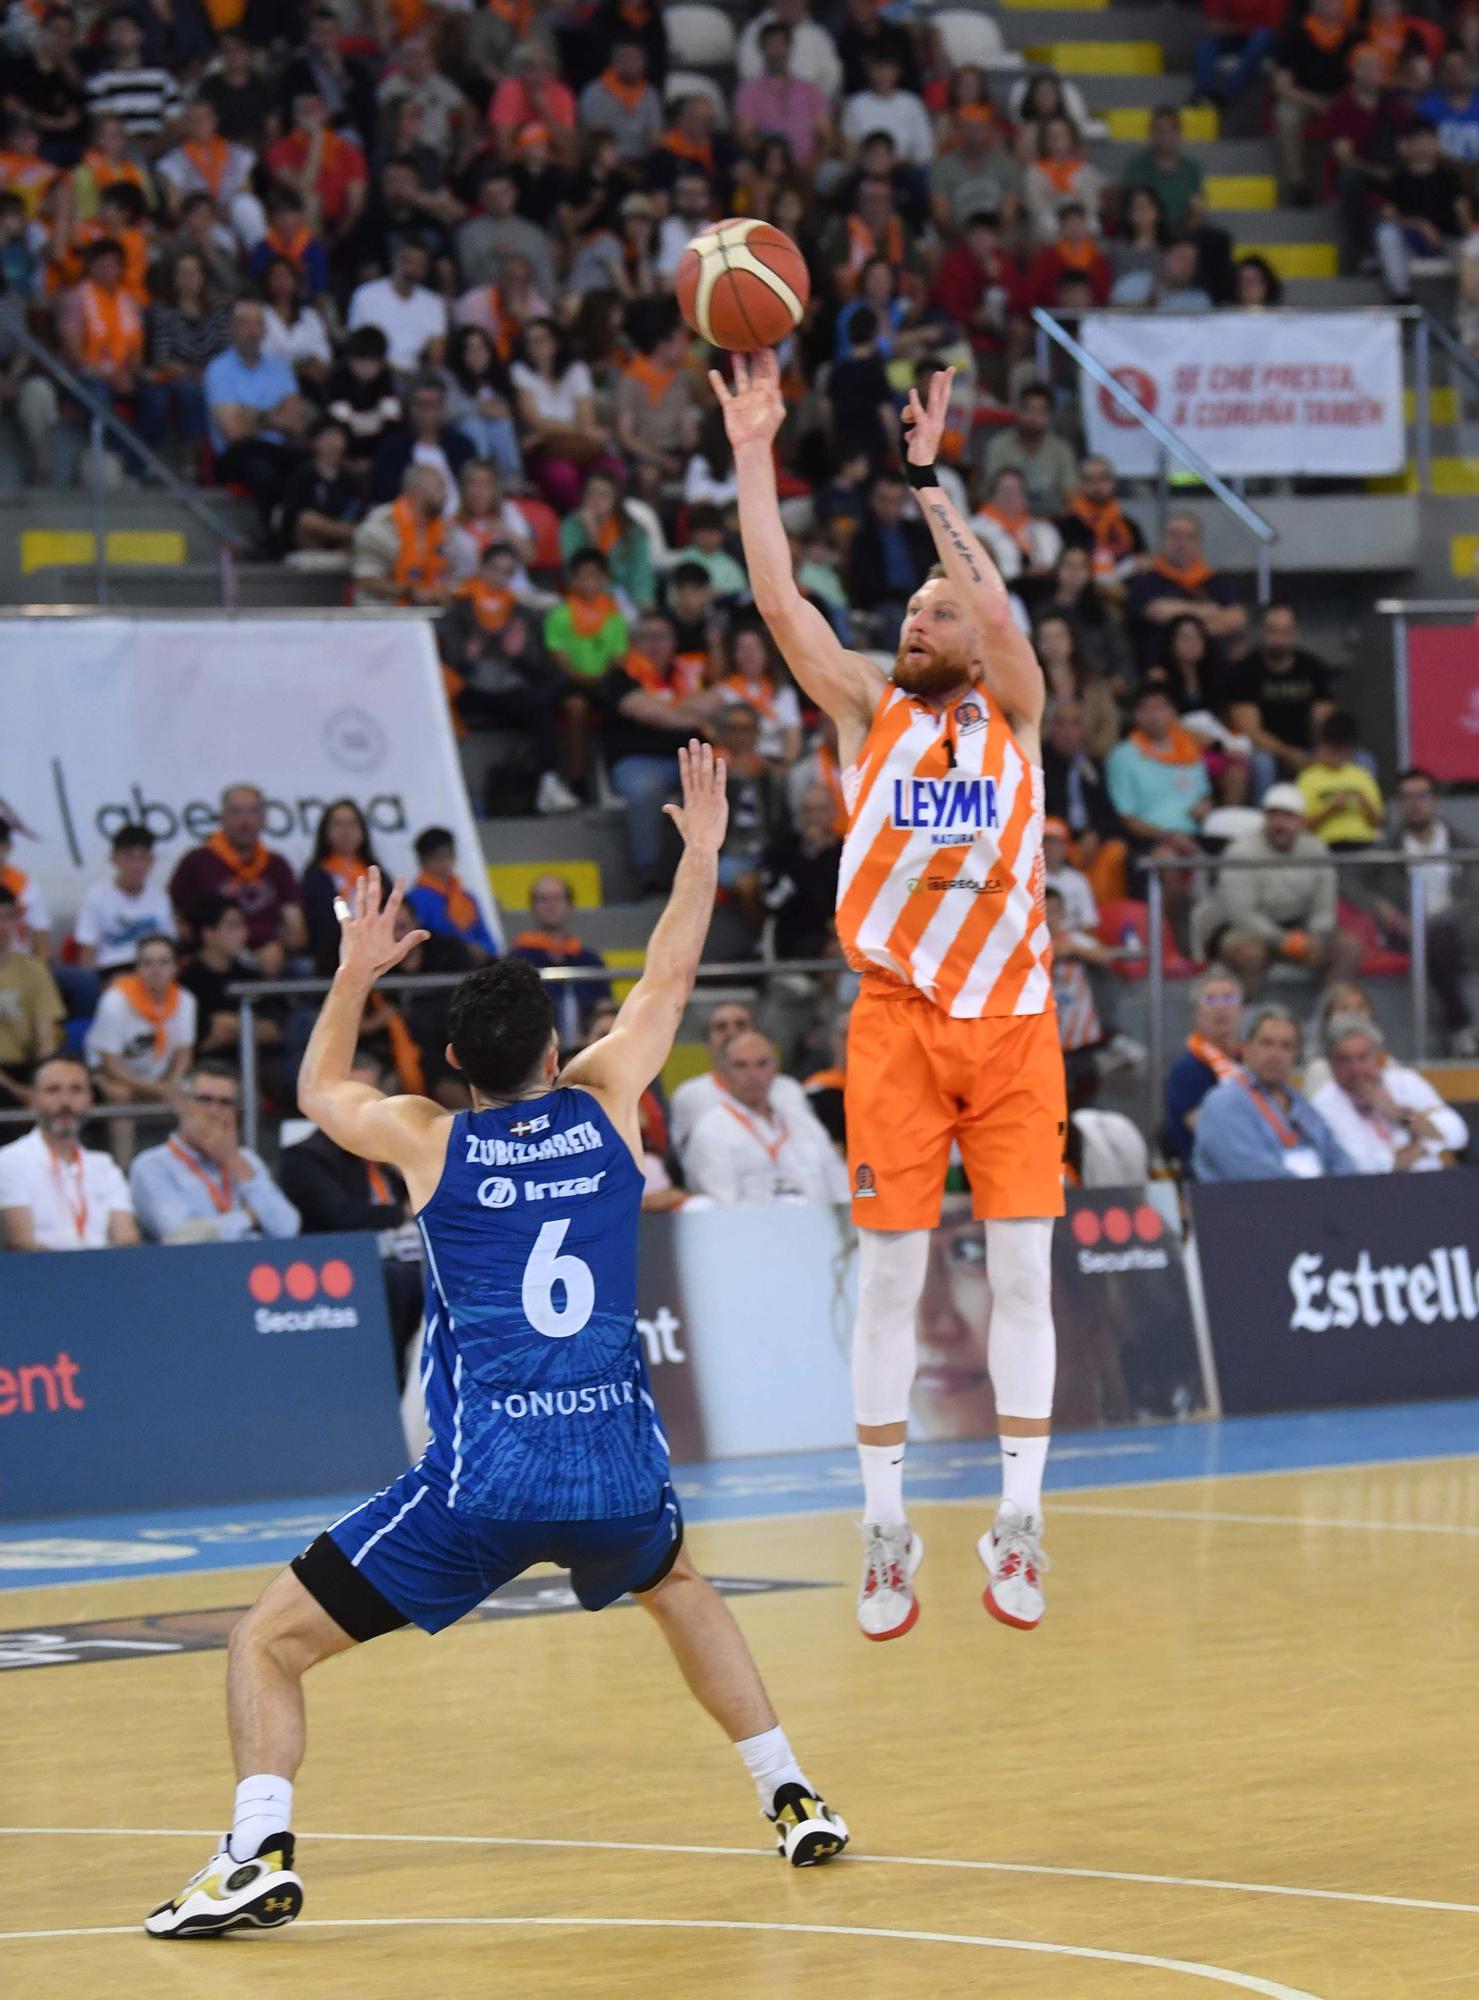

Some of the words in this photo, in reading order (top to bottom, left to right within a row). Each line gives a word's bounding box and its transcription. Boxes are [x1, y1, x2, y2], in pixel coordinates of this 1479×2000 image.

[941, 738, 959, 769] 1
[466, 1121, 603, 1166] ZUBIZARRETA
[521, 1218, 596, 1339] 6
[1078, 1246, 1168, 1274] Securitas
[1288, 1246, 1479, 1333] Estrell
[254, 1304, 358, 1334] Securitas
